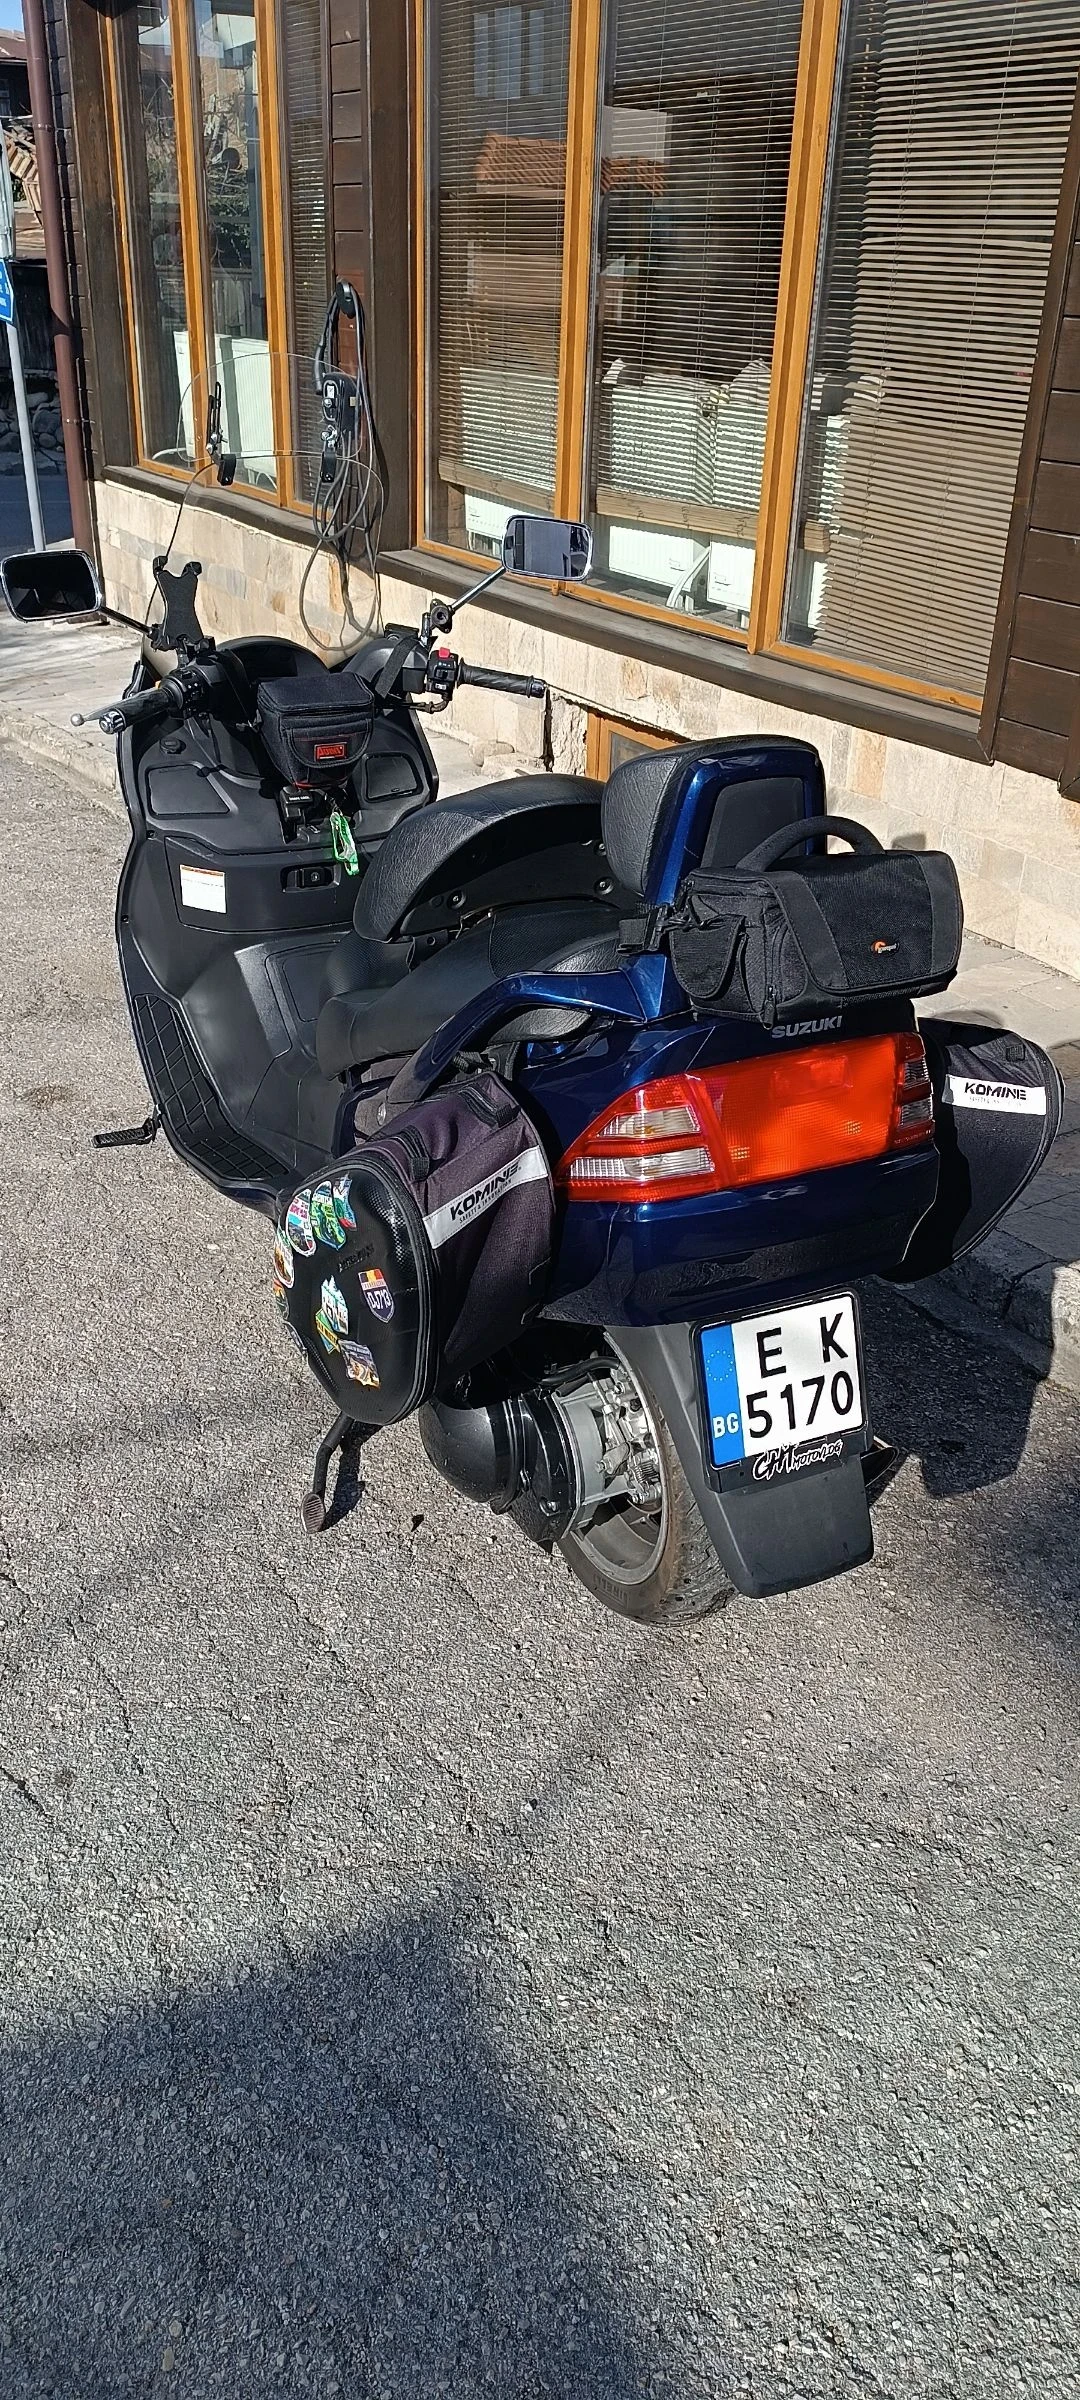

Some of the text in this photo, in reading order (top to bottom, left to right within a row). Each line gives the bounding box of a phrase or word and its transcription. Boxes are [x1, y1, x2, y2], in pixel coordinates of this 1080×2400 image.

[771, 1015, 843, 1039] SUZUKI
[964, 1082, 1027, 1101] KOMINE
[450, 1161, 519, 1221] KOMINE
[756, 1311, 849, 1379] E K
[712, 1412, 740, 1439] BG
[746, 1370, 854, 1439] 5170
